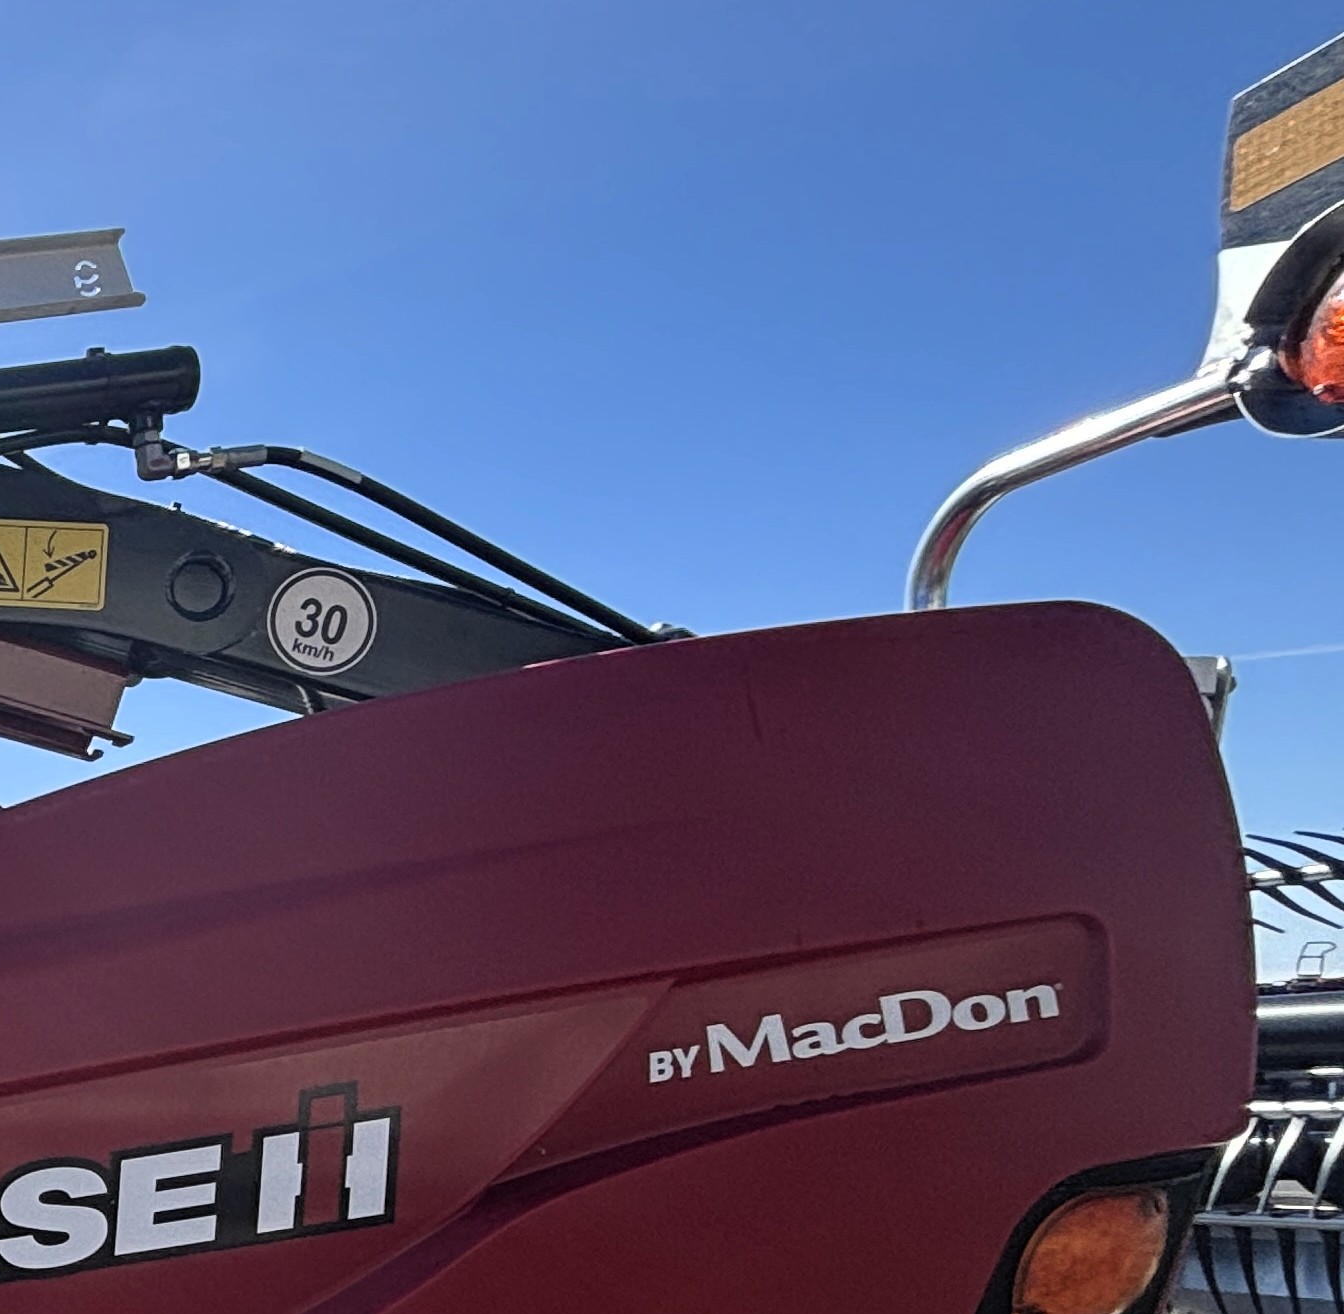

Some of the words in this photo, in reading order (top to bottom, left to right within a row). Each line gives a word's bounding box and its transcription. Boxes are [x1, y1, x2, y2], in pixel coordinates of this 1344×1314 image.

[295, 597, 348, 645] 30
[291, 637, 335, 662] km/h
[649, 1044, 700, 1084] BY
[706, 983, 1060, 1074] MacDon
